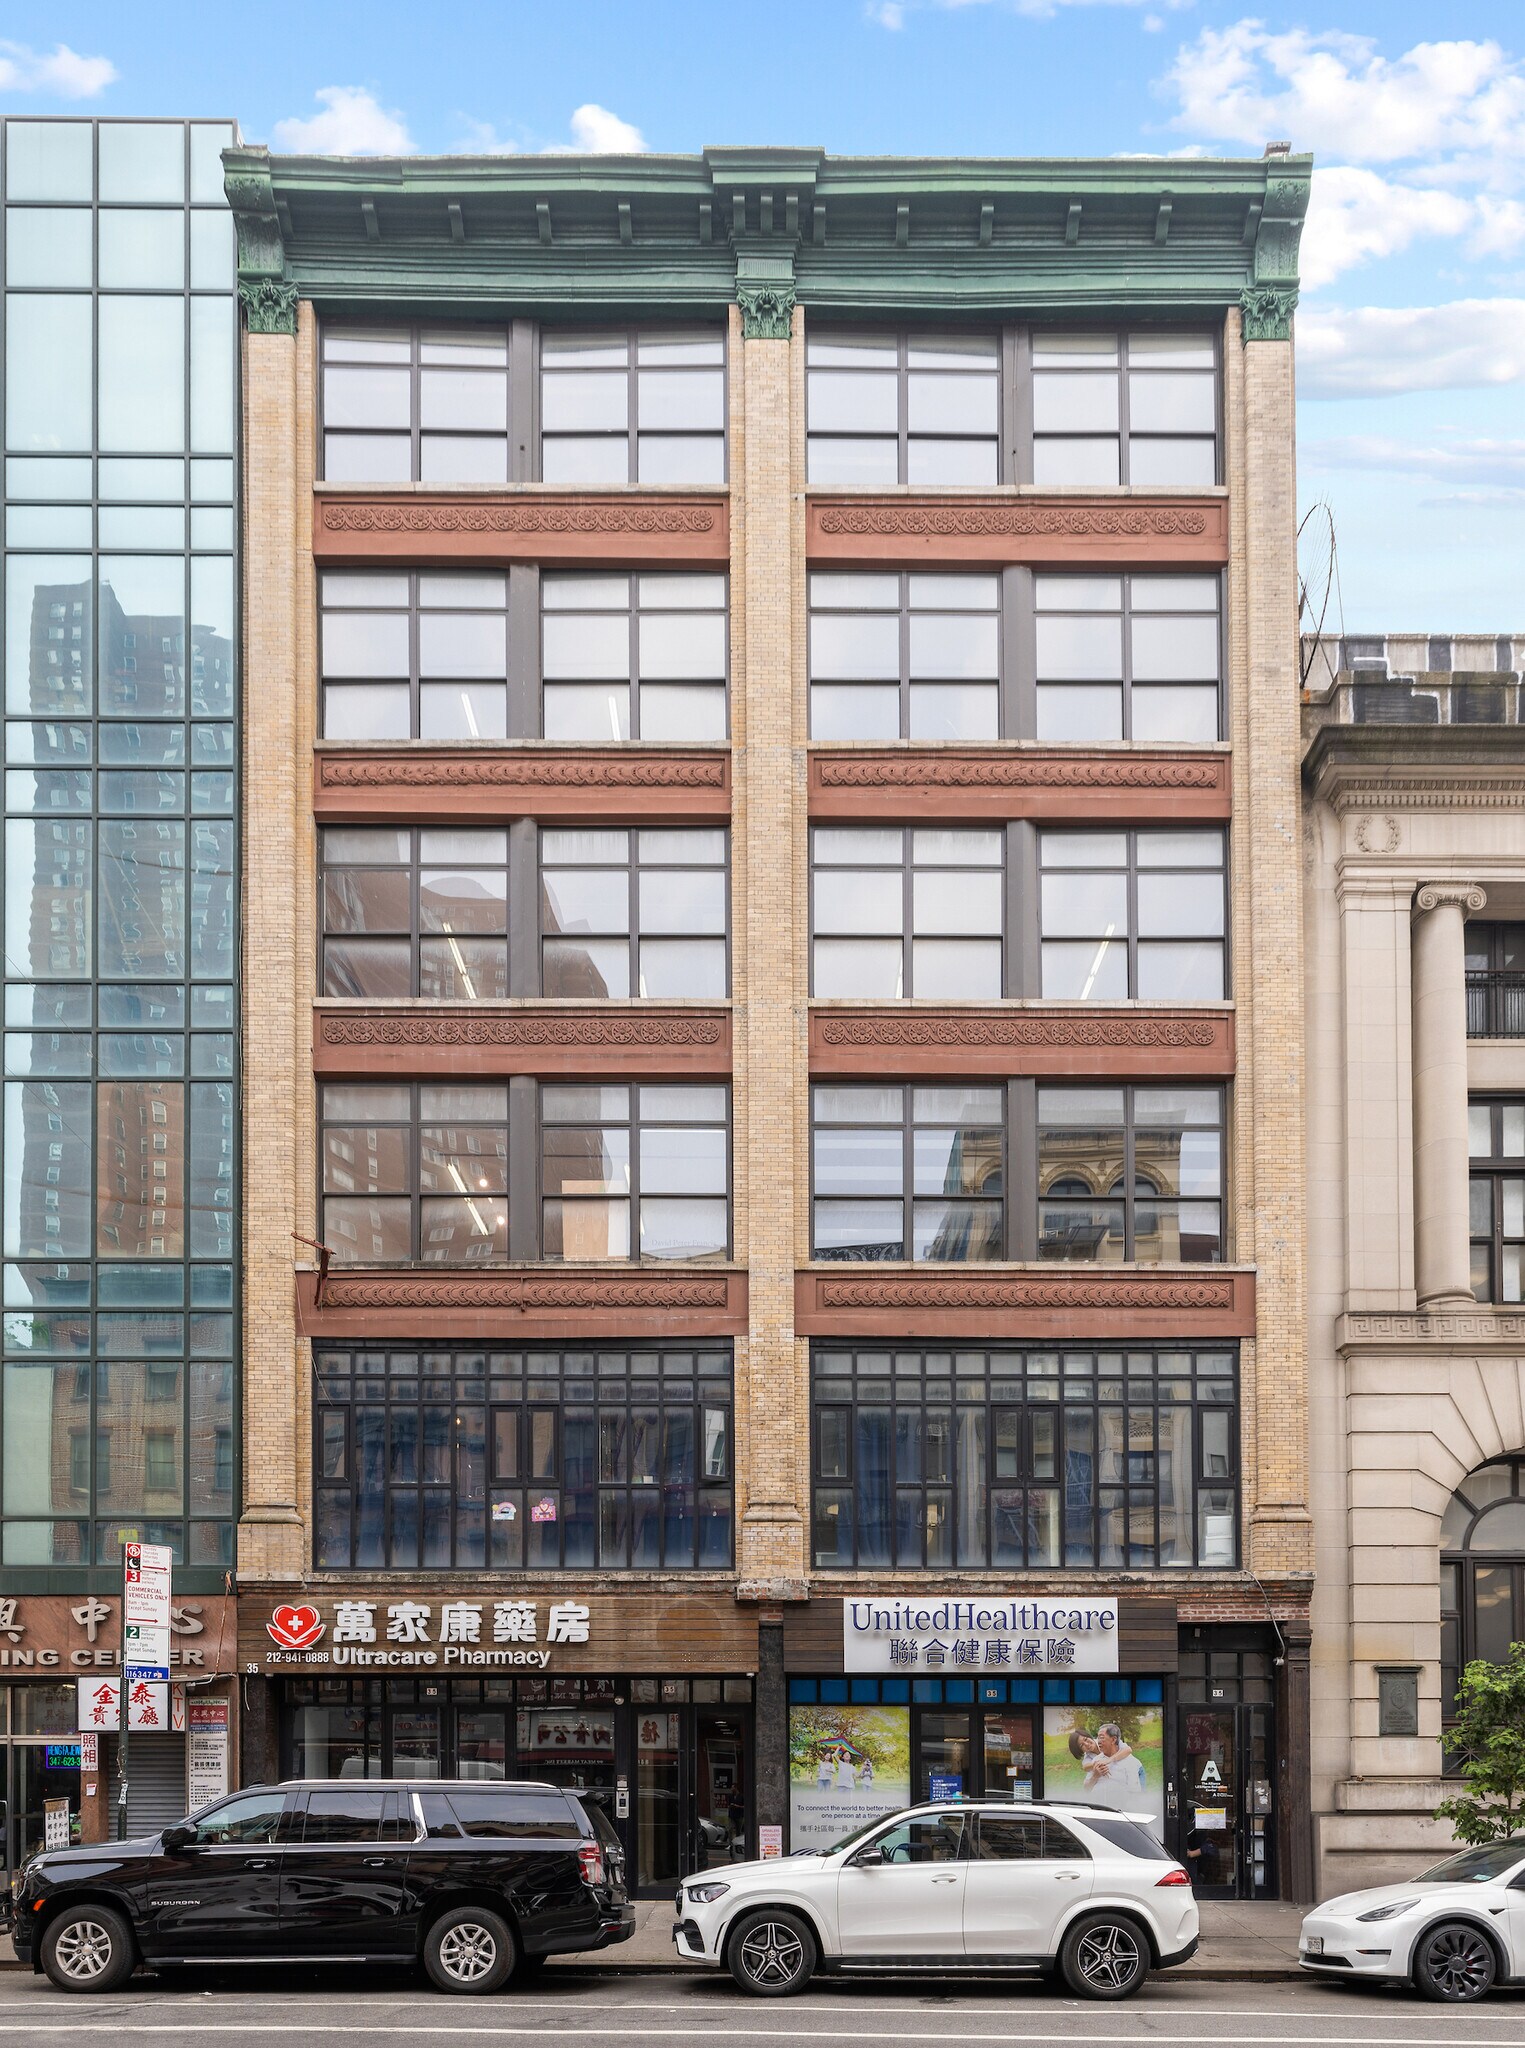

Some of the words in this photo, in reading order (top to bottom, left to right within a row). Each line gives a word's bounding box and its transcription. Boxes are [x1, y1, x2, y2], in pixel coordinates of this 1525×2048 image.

[130, 1571, 138, 1582] 3
[128, 1586, 162, 1595] COMMERCIAL
[333, 1600, 590, 1643] 萬家康藥房
[850, 1601, 1115, 1632] UnitedHealthcare
[129, 1627, 138, 1638] 2
[266, 1652, 329, 1663] 212-941-0888
[333, 1647, 438, 1665] Ultracare
[444, 1647, 551, 1669] Pharmacy
[889, 1637, 1077, 1665] 聯合健康保險
[126, 1670, 153, 1678] 116347
[246, 1663, 259, 1674] 35
[92, 1682, 157, 1705] 金泰
[82, 1734, 97, 1763] 照相
